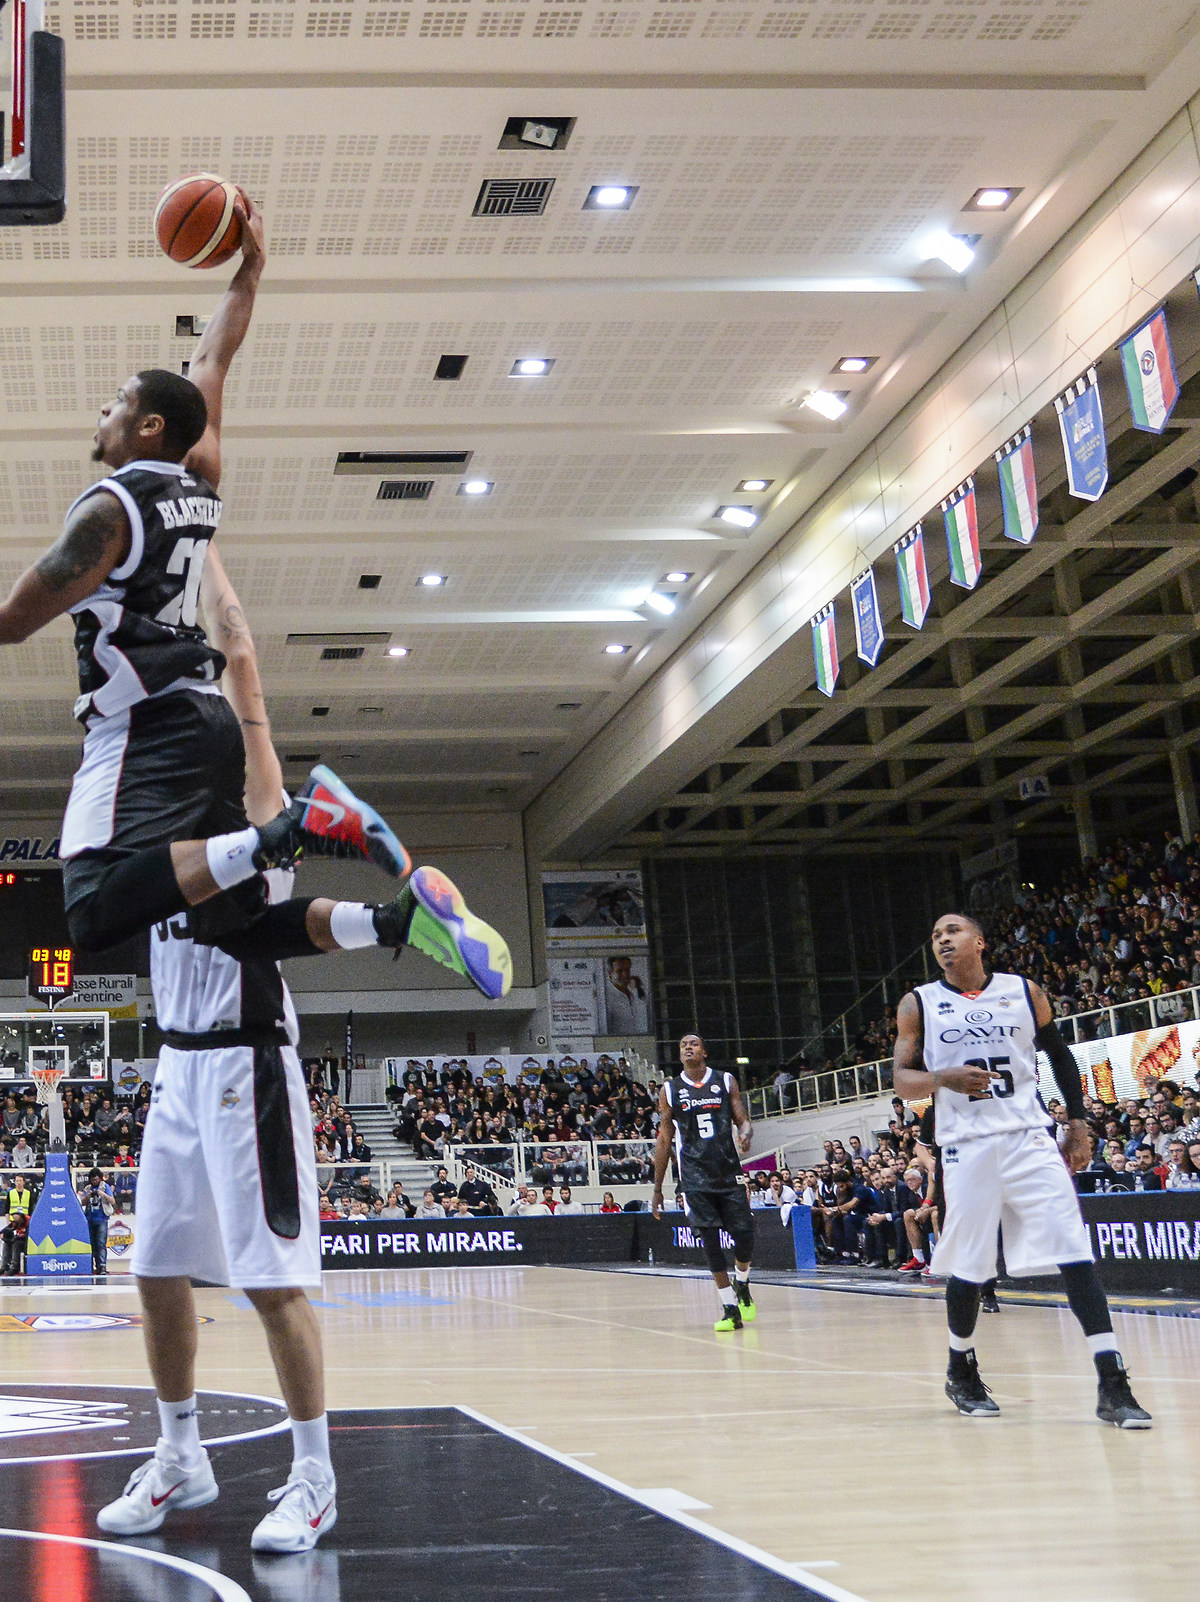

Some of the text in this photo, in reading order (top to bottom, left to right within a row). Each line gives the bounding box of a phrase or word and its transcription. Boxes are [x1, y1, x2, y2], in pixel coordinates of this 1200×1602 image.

[32, 948, 72, 962] 03 48
[42, 962, 71, 987] 18
[73, 976, 133, 989] asse Rurali
[939, 1025, 1021, 1044] CAVIT
[696, 1113, 715, 1139] 5
[320, 1230, 523, 1256] FARI PER MIRARE.
[1096, 1221, 1142, 1260] PER
[41, 1258, 78, 1272] TRENTINO
